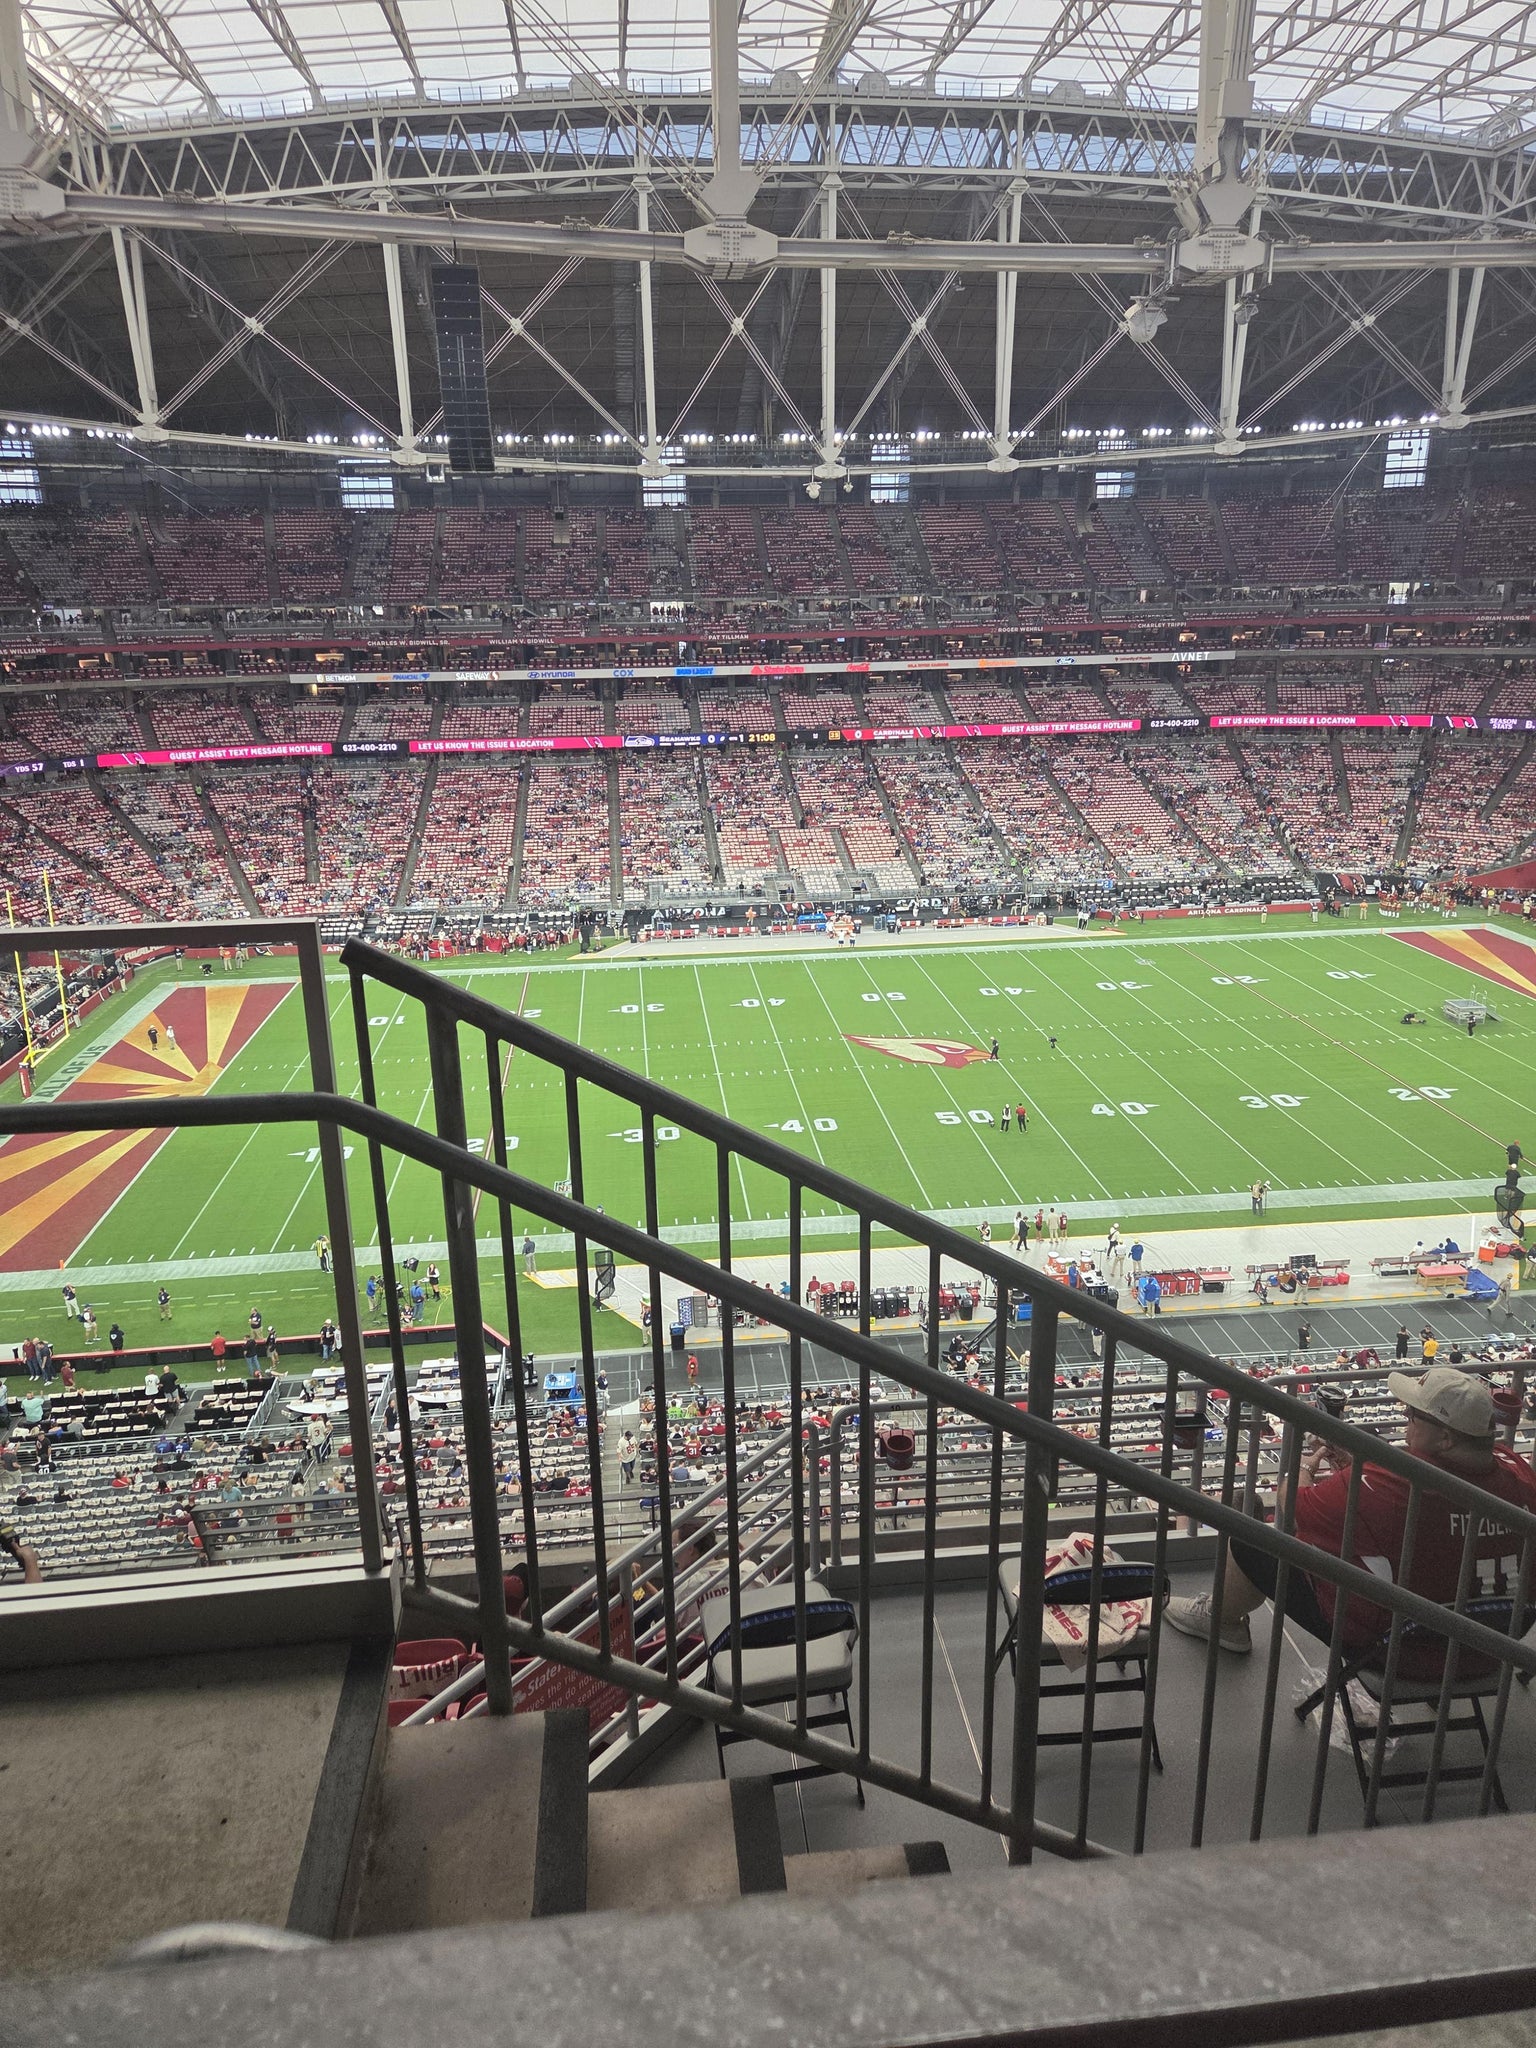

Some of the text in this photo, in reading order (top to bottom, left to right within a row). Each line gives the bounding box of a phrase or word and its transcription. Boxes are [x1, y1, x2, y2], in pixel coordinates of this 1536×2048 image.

[10, 647, 47, 655] WILLIAMS
[325, 674, 356, 682] BETMGM
[455, 672, 489, 681] SAFEWAY
[613, 669, 634, 677] COX
[1150, 718, 1199, 728] 623-400-2210
[1219, 717, 1231, 725] LET
[1232, 717, 1243, 725] US
[1285, 716, 1308, 724] ISSUE
[1309, 716, 1315, 724] &
[1316, 716, 1356, 724] LOCATION
[1002, 721, 1133, 733] GUEST ASSIST TEXT MESSAGE HOTLINE
[707, 734, 715, 743] 0
[749, 733, 776, 742] 21:08
[855, 730, 862, 738] 0
[342, 743, 397, 751] 623-400-2210
[418, 742, 432, 750] LET
[433, 742, 445, 750] US
[445, 741, 469, 750] KNOW
[471, 741, 485, 749] THE
[487, 741, 508, 749] ISSUE
[516, 740, 554, 748] LOCATION
[169, 745, 323, 760] GUEST ASSIST TEXT MESSAGE HOTLINE
[15, 763, 43, 773] YDS 57
[63, 761, 76, 769] TDS
[1187, 905, 1268, 916] ARIZONA CARDINAL
[1211, 975, 1259, 985] 20
[1326, 970, 1368, 980] 10
[1096, 981, 1143, 991] 30
[861, 991, 907, 1002] 50
[979, 987, 1023, 996] 40
[741, 998, 785, 1008] 40
[621, 1003, 664, 1014] 30
[368, 1015, 405, 1026] 10
[37, 1076, 74, 1098] ALL
[61, 1061, 88, 1074] OF
[78, 1045, 109, 1059] US
[1388, 1086, 1452, 1101] 20
[1238, 1094, 1302, 1109] 30
[1091, 1101, 1149, 1117] 40
[935, 1109, 993, 1124] 50
[781, 1118, 838, 1133] 40
[623, 1126, 681, 1143] 30
[547, 1683, 562, 1699] the
[610, 1630, 627, 1648] seat
[565, 1687, 577, 1699] do
